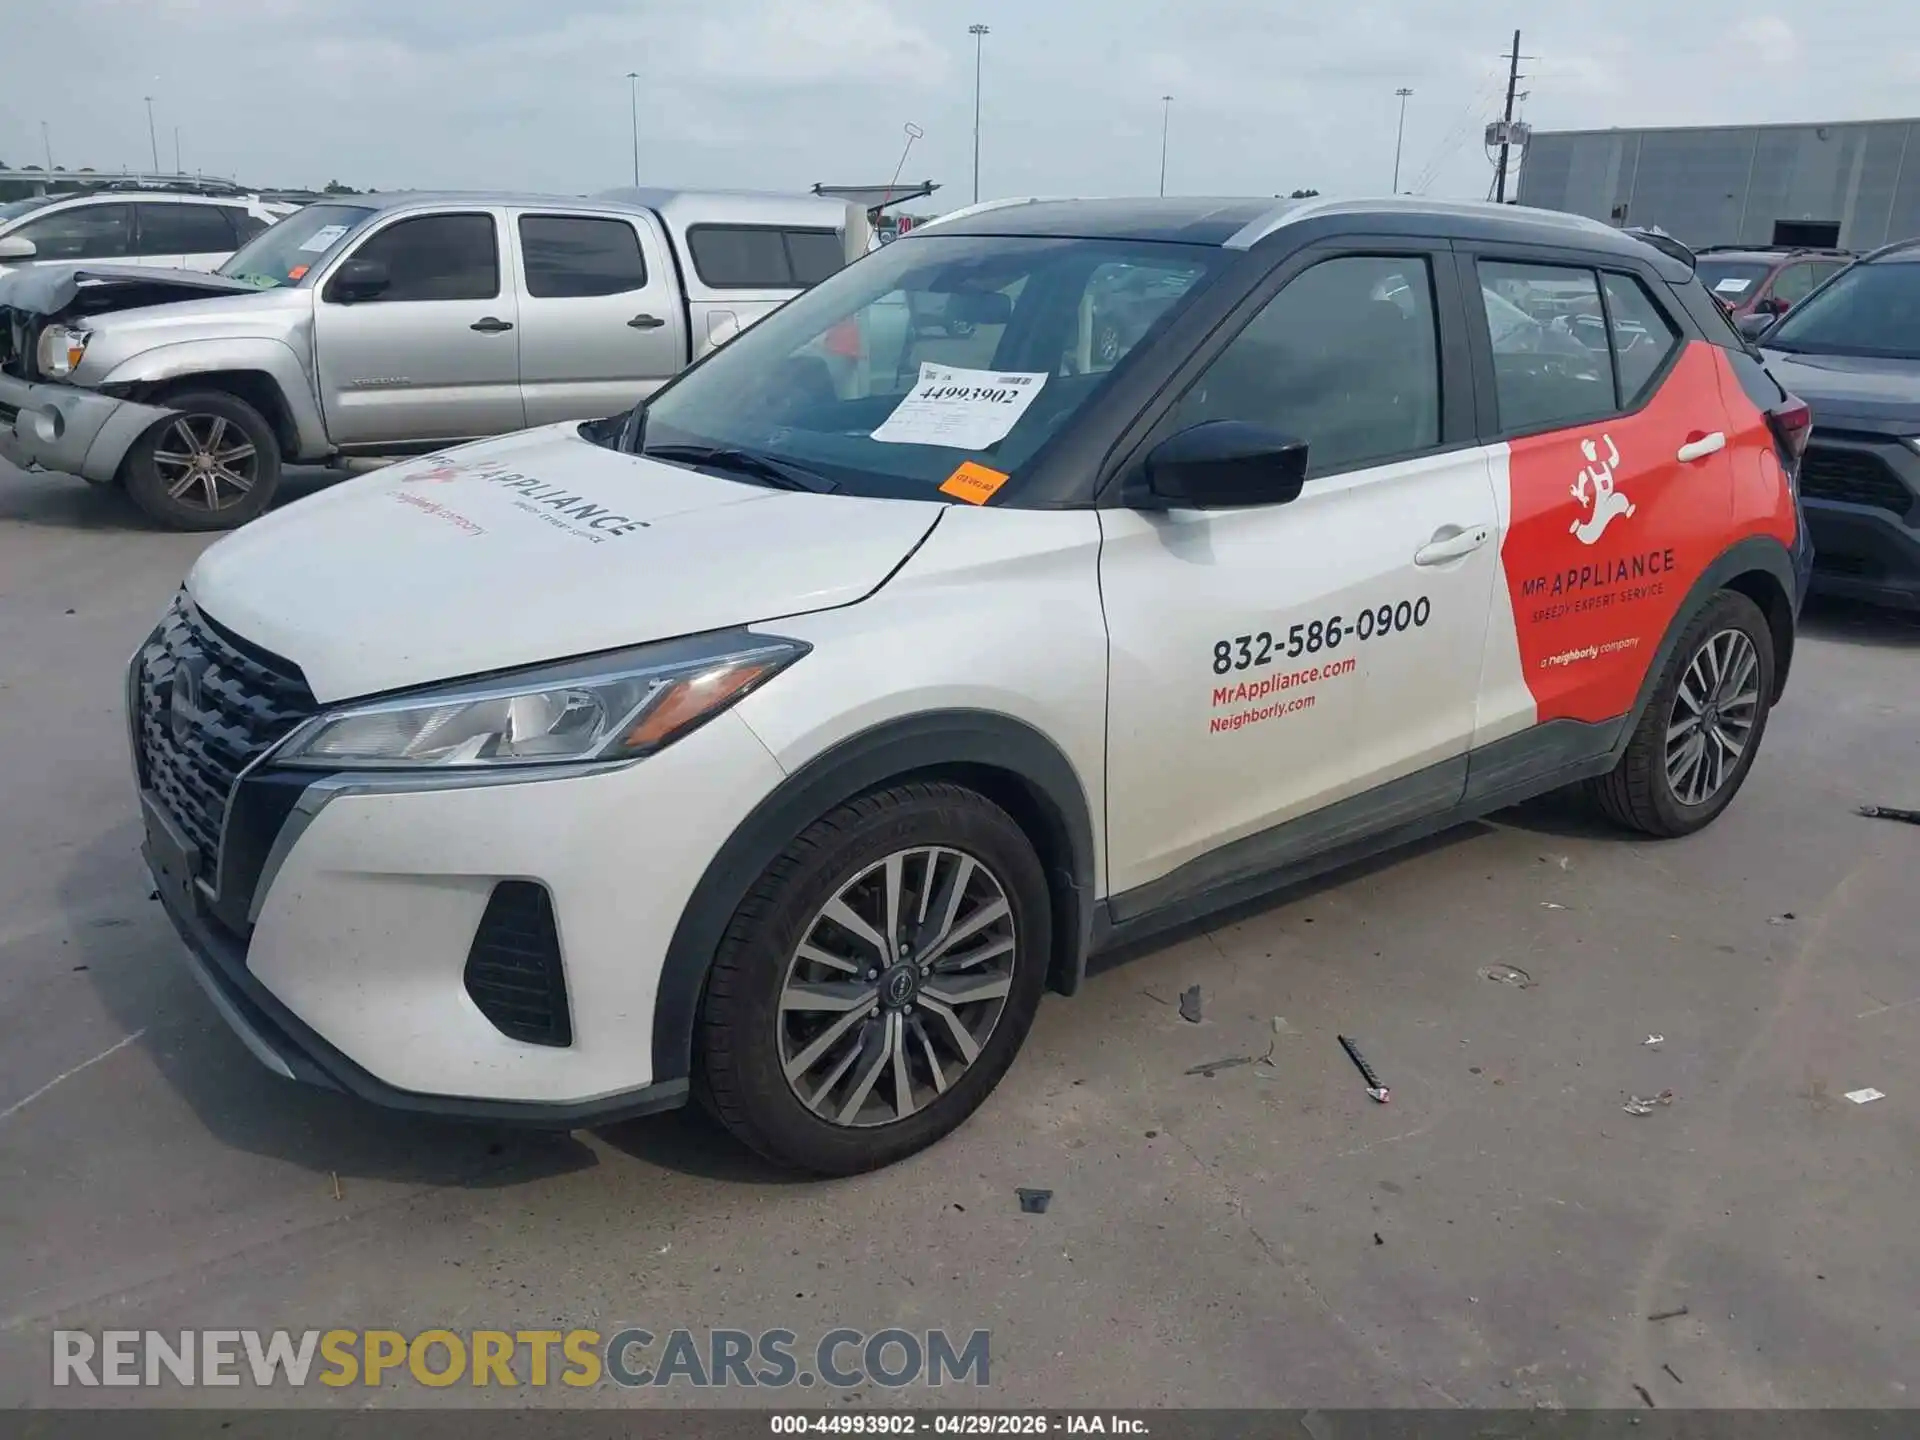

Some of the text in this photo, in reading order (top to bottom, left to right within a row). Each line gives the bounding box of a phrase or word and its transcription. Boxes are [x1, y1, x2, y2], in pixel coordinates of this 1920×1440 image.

[920, 386, 1019, 404] 44993902
[468, 470, 651, 536] APPLIANCE
[1550, 549, 1675, 597] APPLIANCE
[1531, 582, 1665, 623] SPEEDY EXPERT SERVICE
[1212, 595, 1431, 675] 832-586-0900
[1548, 645, 1598, 666] neighborly
[1600, 637, 1640, 653] company
[1212, 656, 1356, 707] MrAppliance.com
[1209, 694, 1316, 734] Neighborly.com
